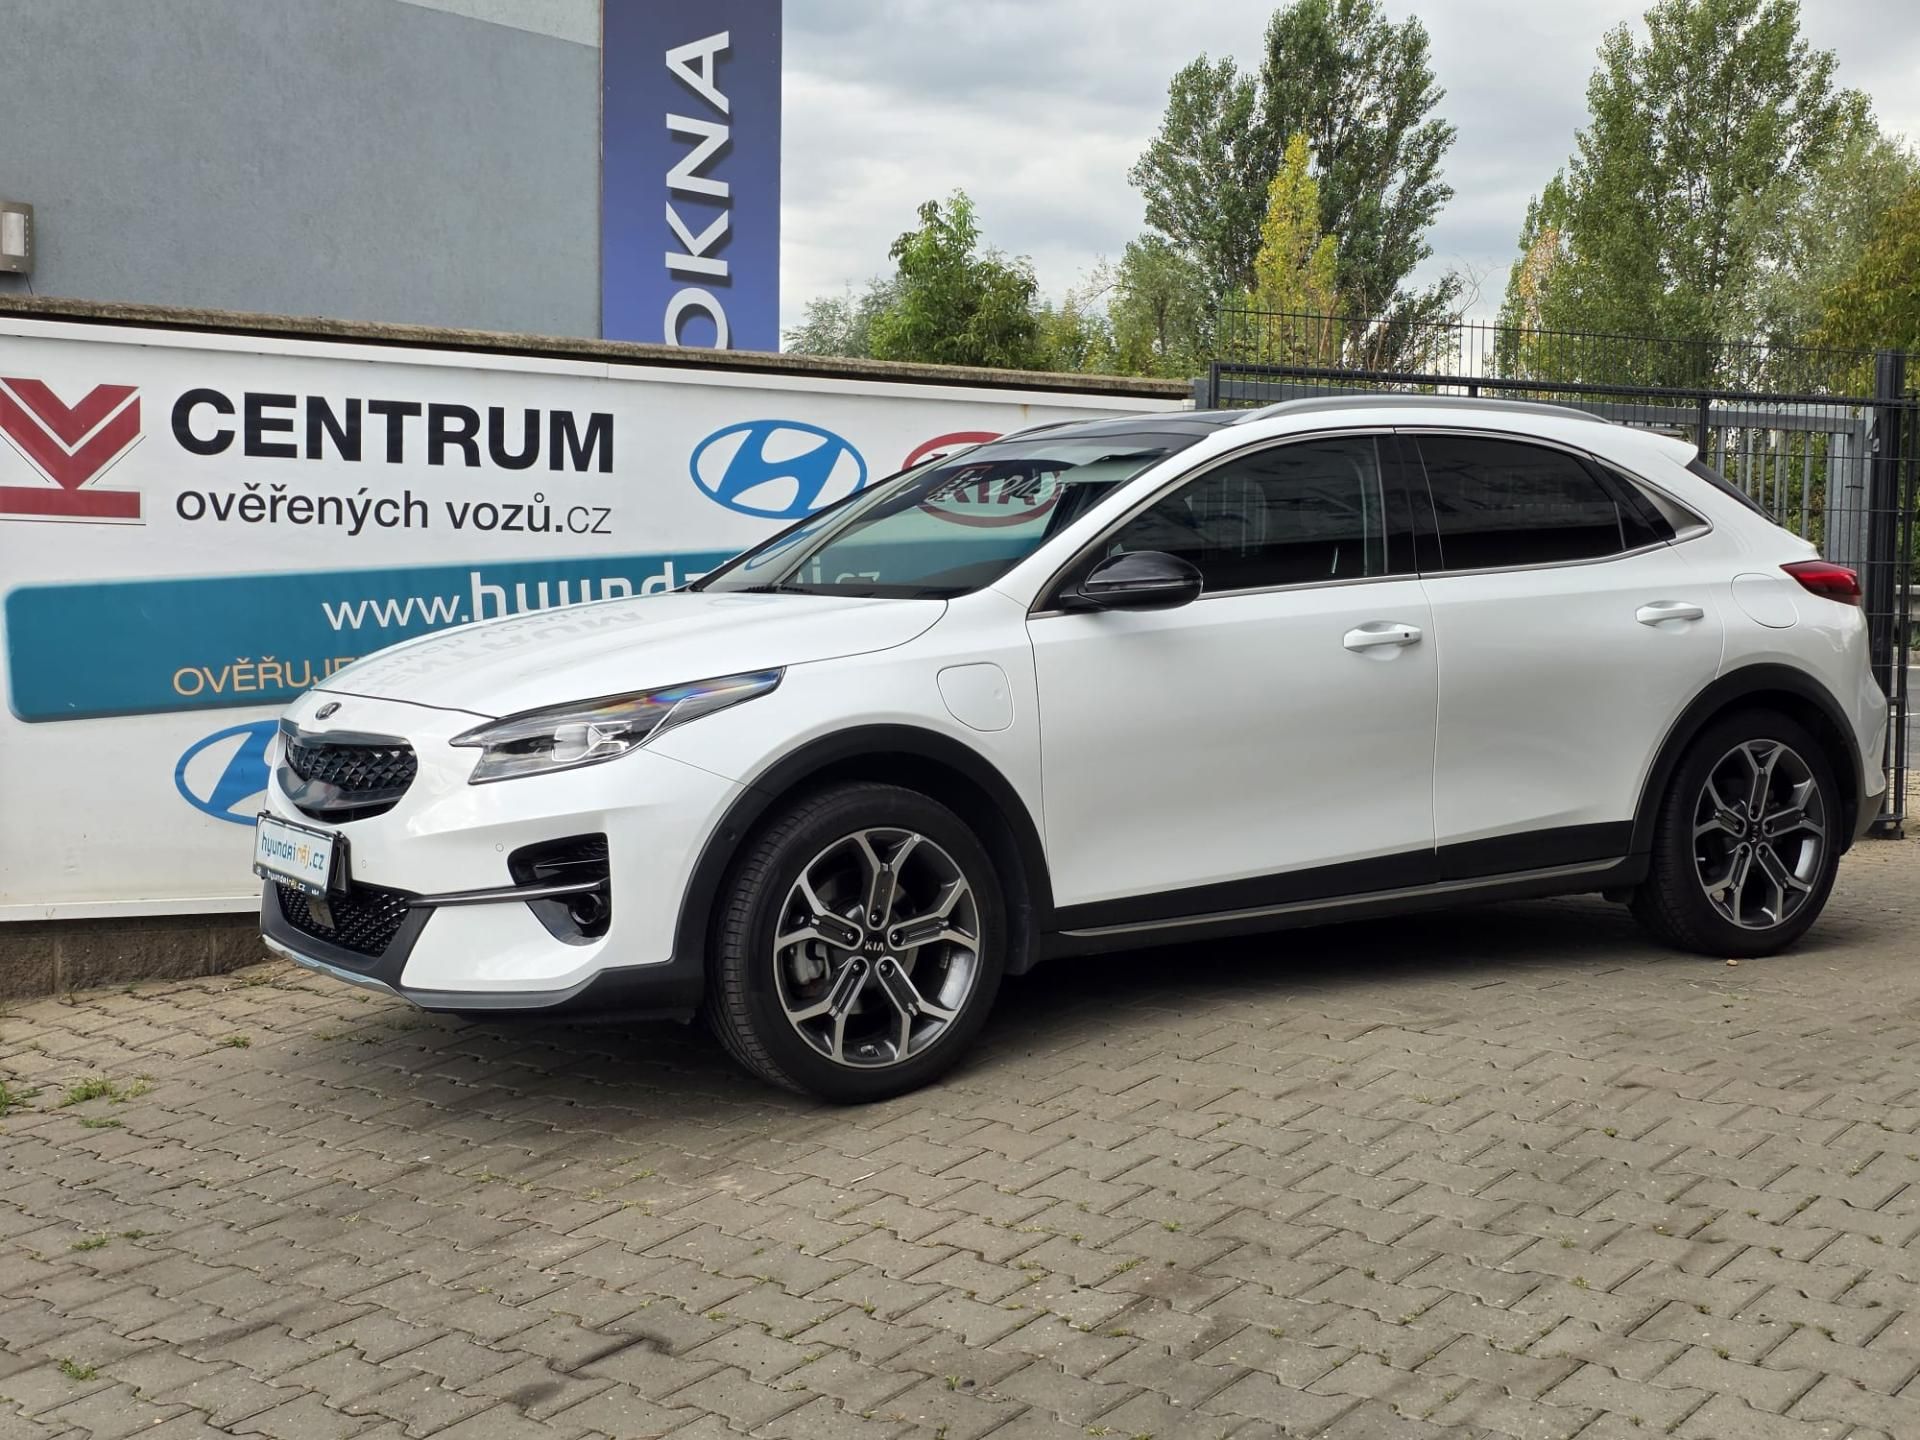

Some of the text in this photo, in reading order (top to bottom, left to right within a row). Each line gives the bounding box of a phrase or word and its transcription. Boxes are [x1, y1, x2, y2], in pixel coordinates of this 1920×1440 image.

[664, 30, 730, 350] OKNA
[171, 387, 614, 473] CENTRUM
[175, 482, 613, 537] ověřených vozů.cz
[864, 940, 885, 951] KIA
